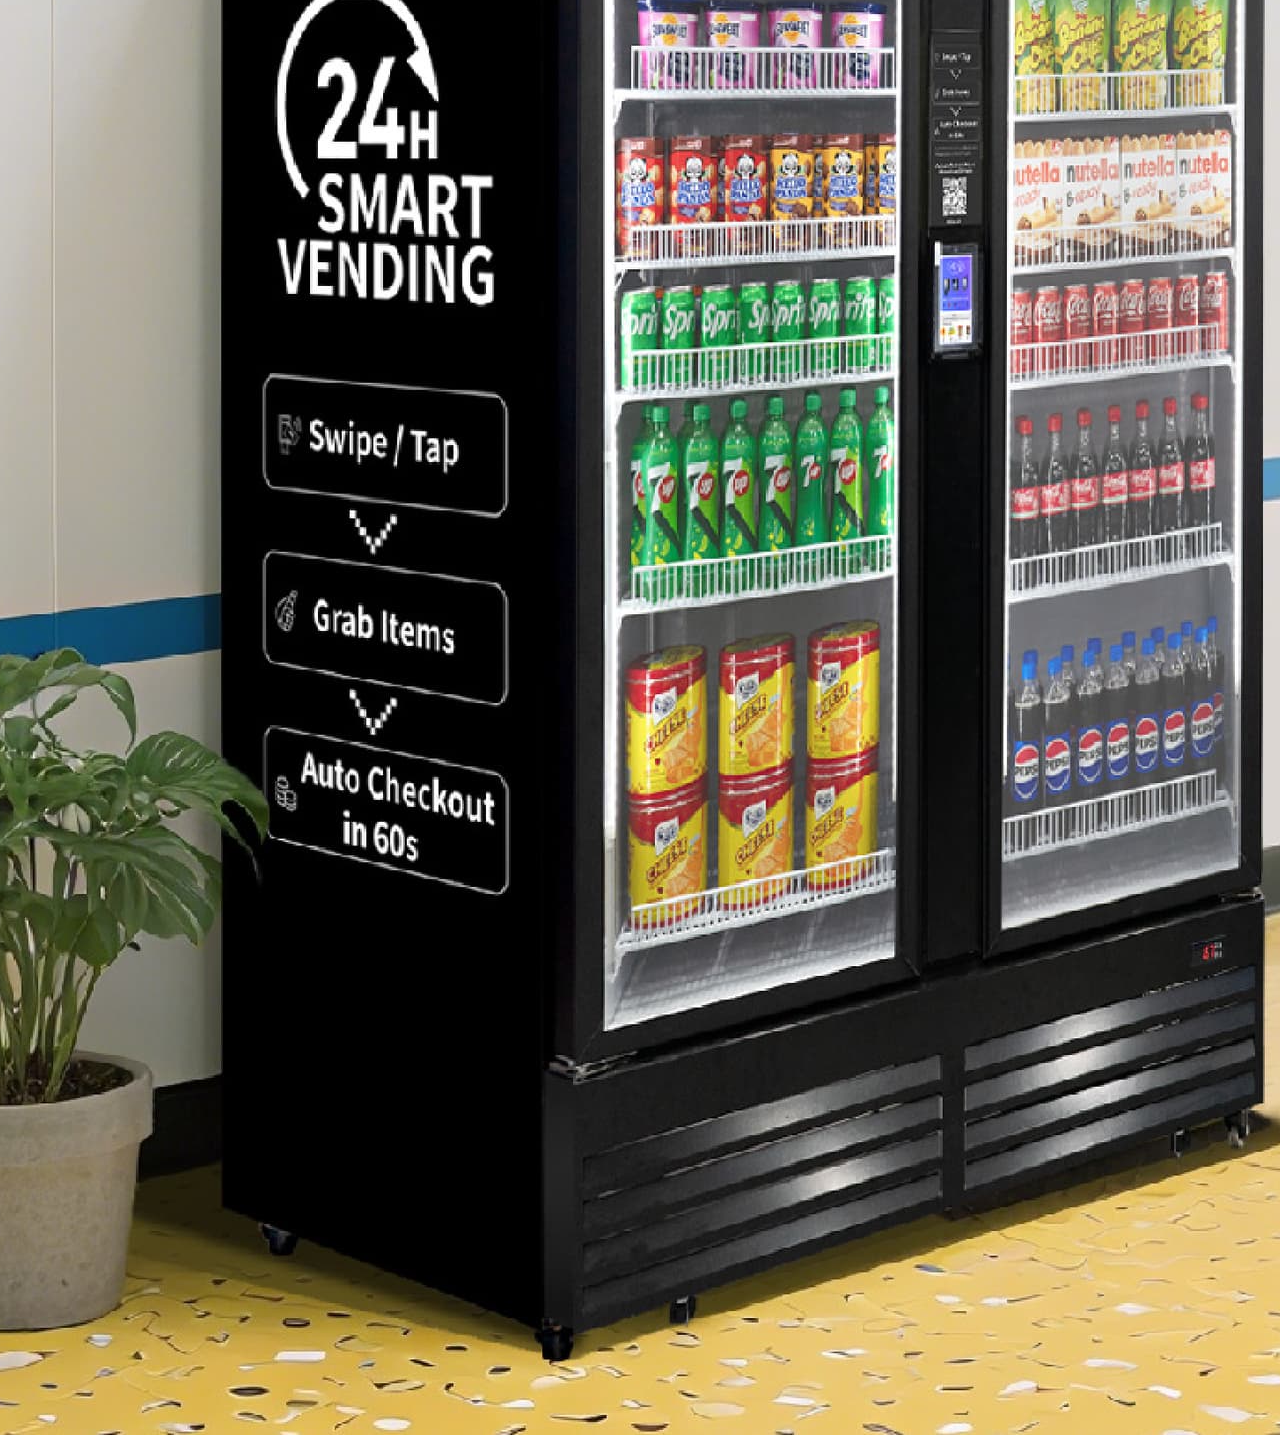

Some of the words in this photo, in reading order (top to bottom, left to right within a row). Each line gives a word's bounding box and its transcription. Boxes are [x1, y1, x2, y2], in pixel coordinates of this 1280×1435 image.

[317, 55, 439, 159] 24H
[1014, 161, 1060, 186] utella
[1067, 158, 1120, 183] nutella
[1125, 155, 1175, 181] nutella
[1179, 150, 1229, 176] nutella
[317, 172, 493, 239] SMART
[276, 237, 495, 307] VENDING
[309, 419, 388, 465] Swipe
[393, 423, 404, 468] /
[410, 430, 460, 474] Tap
[313, 597, 374, 640] Grab
[382, 609, 455, 655] Items
[301, 751, 360, 794] Auto
[367, 766, 495, 826] Checkout
[342, 809, 368, 849] in
[373, 821, 419, 862] 60s
